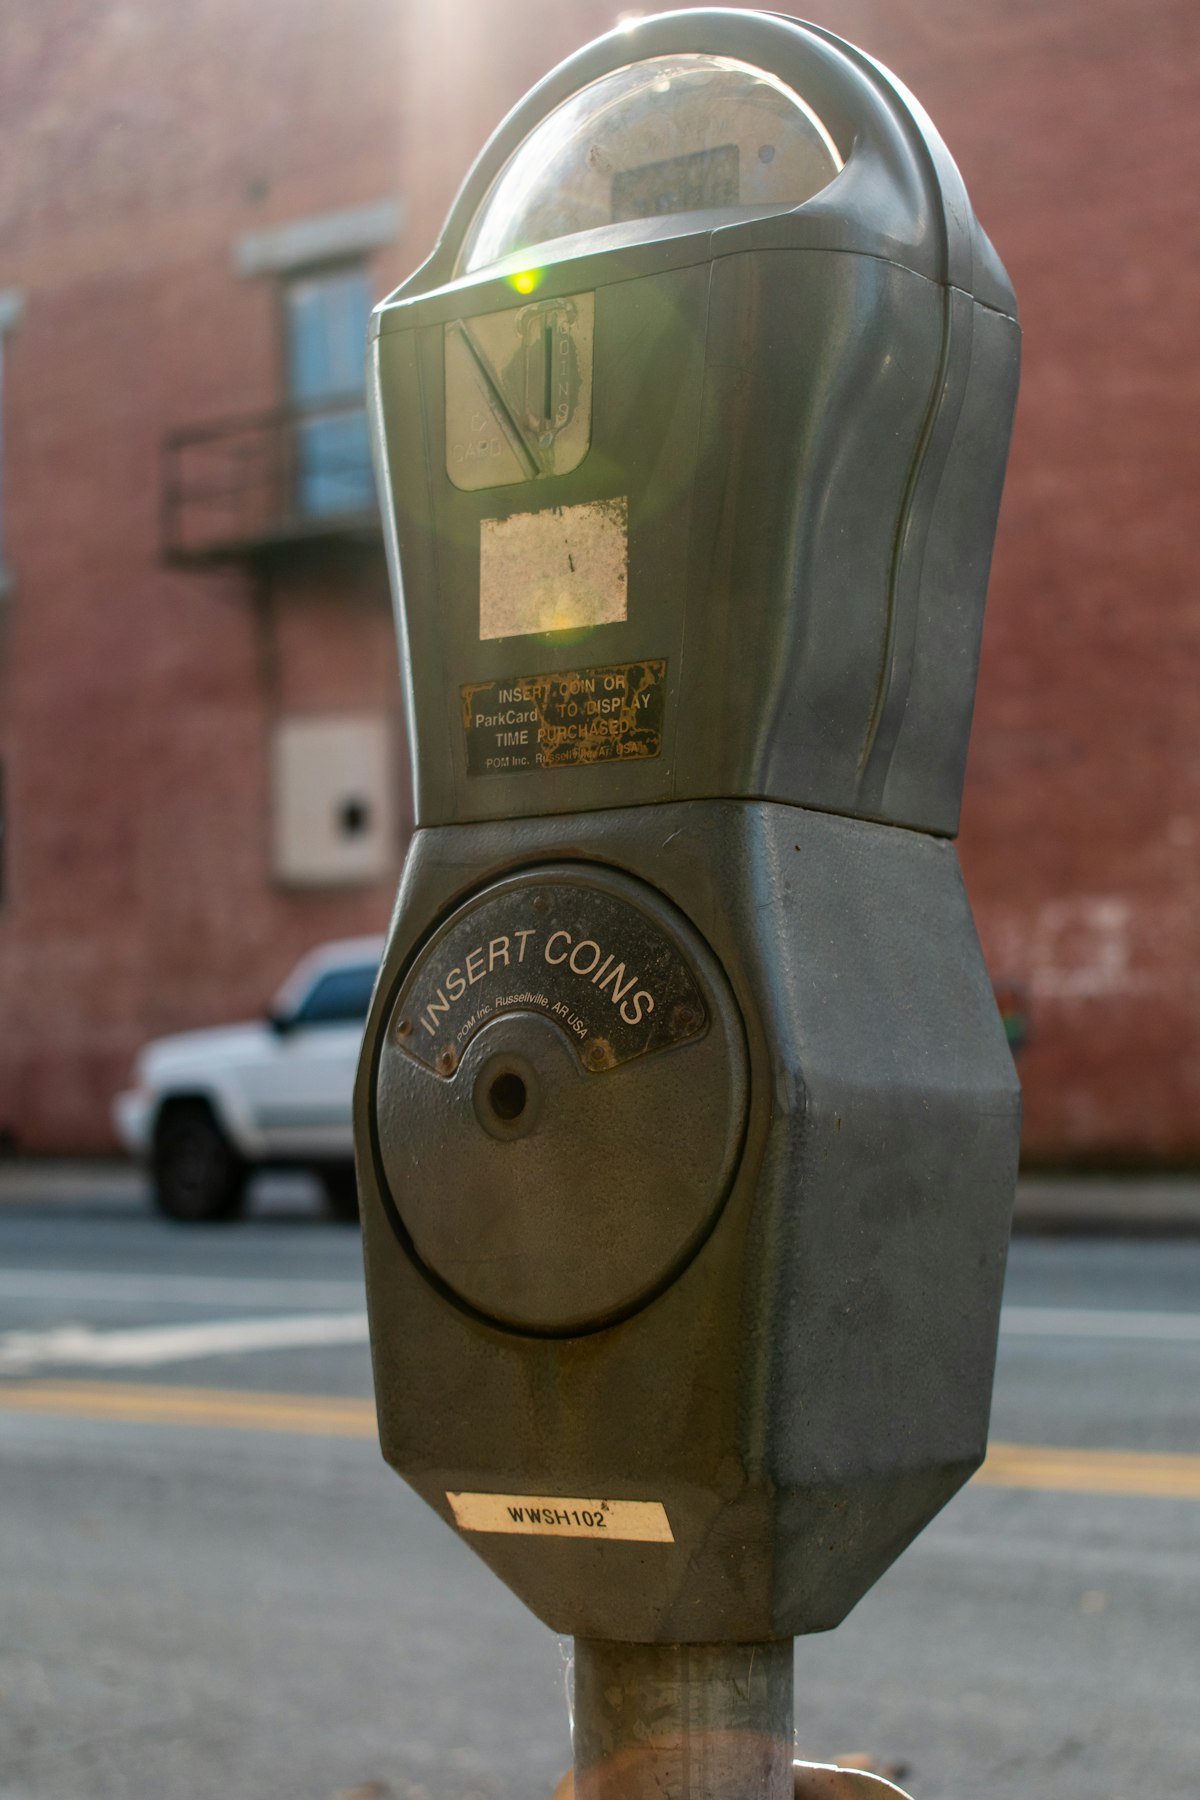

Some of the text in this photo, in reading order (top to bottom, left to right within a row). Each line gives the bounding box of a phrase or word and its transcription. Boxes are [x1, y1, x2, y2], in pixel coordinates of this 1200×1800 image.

[499, 675, 625, 704] INSERT COIN OR
[476, 693, 651, 728] ParkCard TO DISPLAY
[496, 719, 630, 747] TIME PURCHASED
[486, 756, 509, 769] POM
[512, 755, 530, 767] Inc.
[419, 929, 655, 1036] INSERT COINS
[456, 992, 588, 1042] POM Inc. Russellville, AR USA
[507, 1506, 607, 1528] WWSH102
